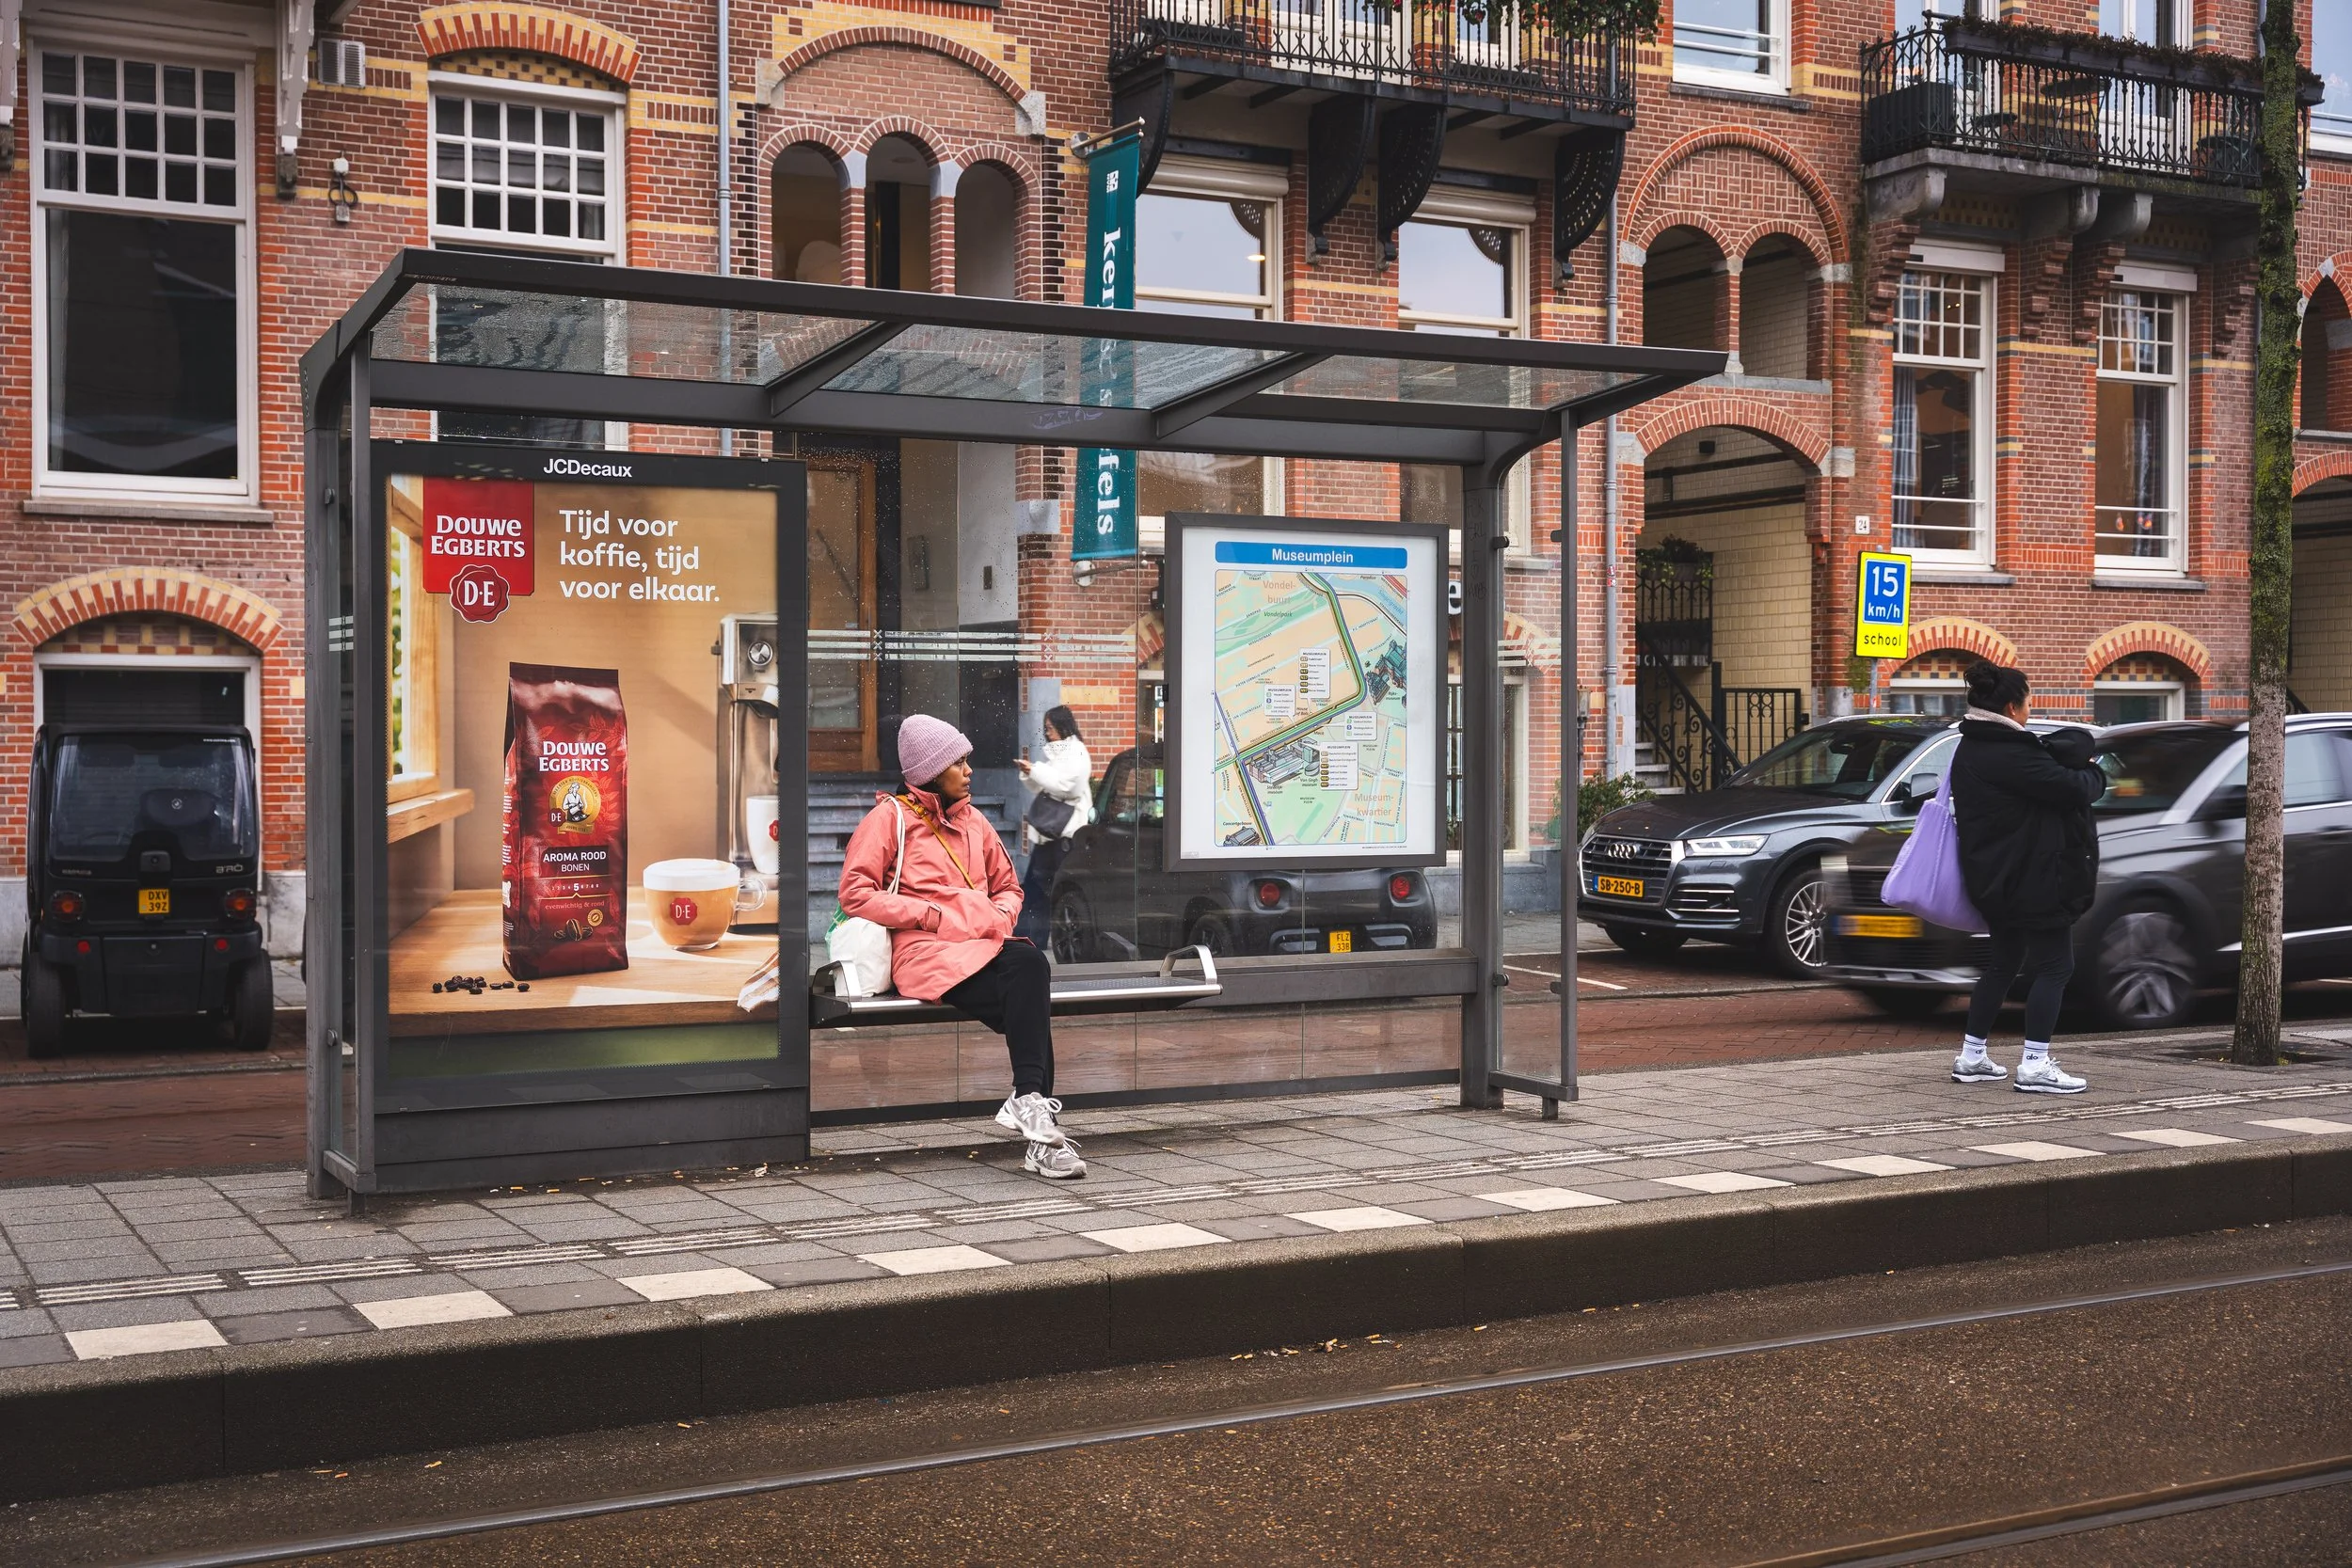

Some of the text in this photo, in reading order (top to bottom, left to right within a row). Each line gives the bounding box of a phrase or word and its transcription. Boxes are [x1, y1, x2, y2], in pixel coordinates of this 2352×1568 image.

[544, 458, 632, 478] JCDecaux
[559, 509, 678, 541] Tijd voor
[1858, 519, 1867, 531] 24
[431, 535, 526, 558] EGBERTS
[560, 541, 699, 576] koffie, tijd
[1271, 548, 1354, 564] Museumplein
[1872, 565, 1899, 597] 15
[559, 576, 720, 602] voor elkaar.
[1867, 602, 1900, 620] km/h
[1864, 633, 1901, 646] school
[539, 756, 610, 771] EGBERTS
[1355, 793, 1393, 802] Museum-
[1357, 808, 1391, 816] kwartier
[543, 851, 607, 863] AROMA ROOD
[561, 863, 590, 872] BONEN
[1599, 877, 1641, 895] SB-250-B
[148, 891, 167, 901] DXV
[149, 902, 167, 911] 39Z
[1337, 933, 1349, 942] FLZ
